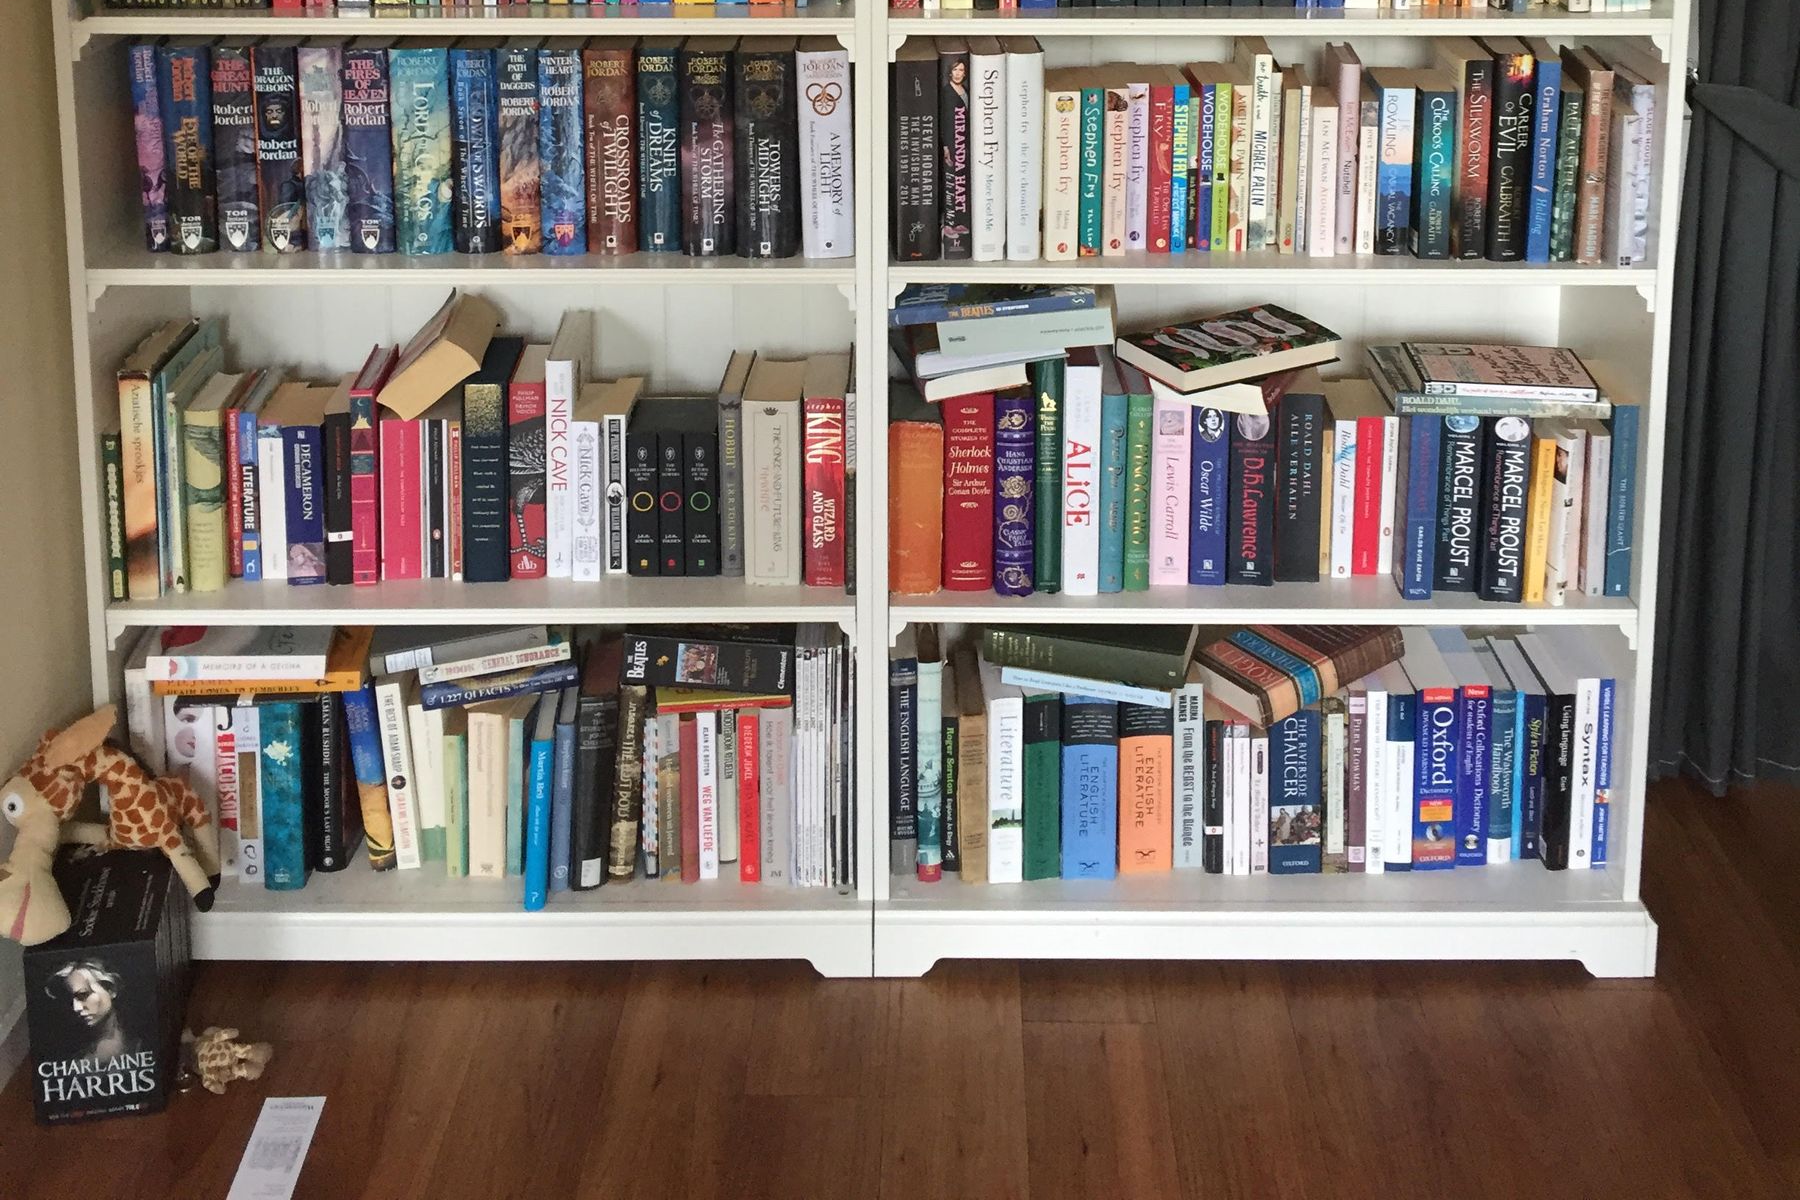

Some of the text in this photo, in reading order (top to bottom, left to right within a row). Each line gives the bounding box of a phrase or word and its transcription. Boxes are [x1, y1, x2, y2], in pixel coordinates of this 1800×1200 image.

[979, 69, 1000, 169] Stephen Fry
[1174, 105, 1188, 179] STEPHEN FRY
[1202, 92, 1214, 170] WODEHOUSE
[1216, 91, 1229, 169] WODEHOUSE
[1467, 94, 1489, 178] SILKWORM
[1498, 116, 1517, 158] EVIL
[1517, 93, 1534, 150] CAREER
[1539, 87, 1555, 132] Graham
[603, 133, 618, 218] TWILIGHT
[616, 114, 632, 224] CROSSROADS
[650, 122, 664, 193] DREAMS
[662, 127, 676, 177] KNIFE
[699, 147, 713, 199] STORM
[712, 140, 726, 225] GATHERING
[757, 138, 771, 215] MIDNIGHT
[768, 143, 781, 201] TOWERS
[819, 152, 832, 199] LIGHT
[831, 144, 843, 205] MEMORY
[910, 117, 921, 205] THE INVISIBLE MAN
[921, 115, 934, 205] STEVE HOGARTH
[954, 106, 967, 212] MIRANDA HART
[1084, 108, 1101, 198] Stephen Fry
[1128, 108, 1146, 185] stephen fry
[1251, 131, 1268, 206] MICHAEL PALIN
[1429, 153, 1444, 197] CALLING
[1537, 138, 1552, 179] Norton
[1497, 166, 1514, 242] GALBRAITH
[961, 305, 994, 318] BEATLES
[550, 399, 569, 491] NICK CAVE
[806, 412, 843, 464] KING
[948, 444, 992, 458] Sherlock
[948, 461, 991, 476] Holmes
[1288, 414, 1301, 520] ALLE VERHALEN
[1302, 414, 1314, 497] ROALD DAHL
[243, 466, 255, 529] LITERATURE
[301, 443, 314, 520] DECAMERON
[1165, 456, 1180, 539] Lewis Carroll
[1199, 461, 1214, 532] Oscar Wilde
[1450, 442, 1478, 567] MARCEL PROUST
[1498, 450, 1525, 577] MARCEL PROUST
[812, 490, 825, 548] AND GLASS
[823, 499, 836, 541] WIZARD
[1179, 695, 1188, 723] WARNER
[1182, 727, 1195, 747] From
[1190, 696, 1199, 720] MARINA
[901, 689, 912, 810] THE ENGLISH LANGUAGE
[998, 715, 1018, 801] Literature
[1183, 750, 1195, 763] the
[1183, 766, 1195, 791] BEAST
[1283, 717, 1299, 799] CHAUCER
[1298, 718, 1308, 798] THE RIVERSIDE
[1431, 707, 1455, 785] Oxford
[1472, 700, 1487, 833] Oxford Collocations Dictionary
[1579, 722, 1594, 787] Syntax
[703, 786, 714, 853] WEG VAN LIEFDE
[1079, 754, 1090, 838] LITERATURE
[1089, 767, 1100, 825] ENGLISH
[1135, 746, 1145, 828] LITERATURE
[1145, 757, 1156, 815] ENGLISH
[1183, 804, 1195, 817] the
[38, 1051, 156, 1078] CHARLAINE
[43, 1069, 156, 1103] HARRIS
